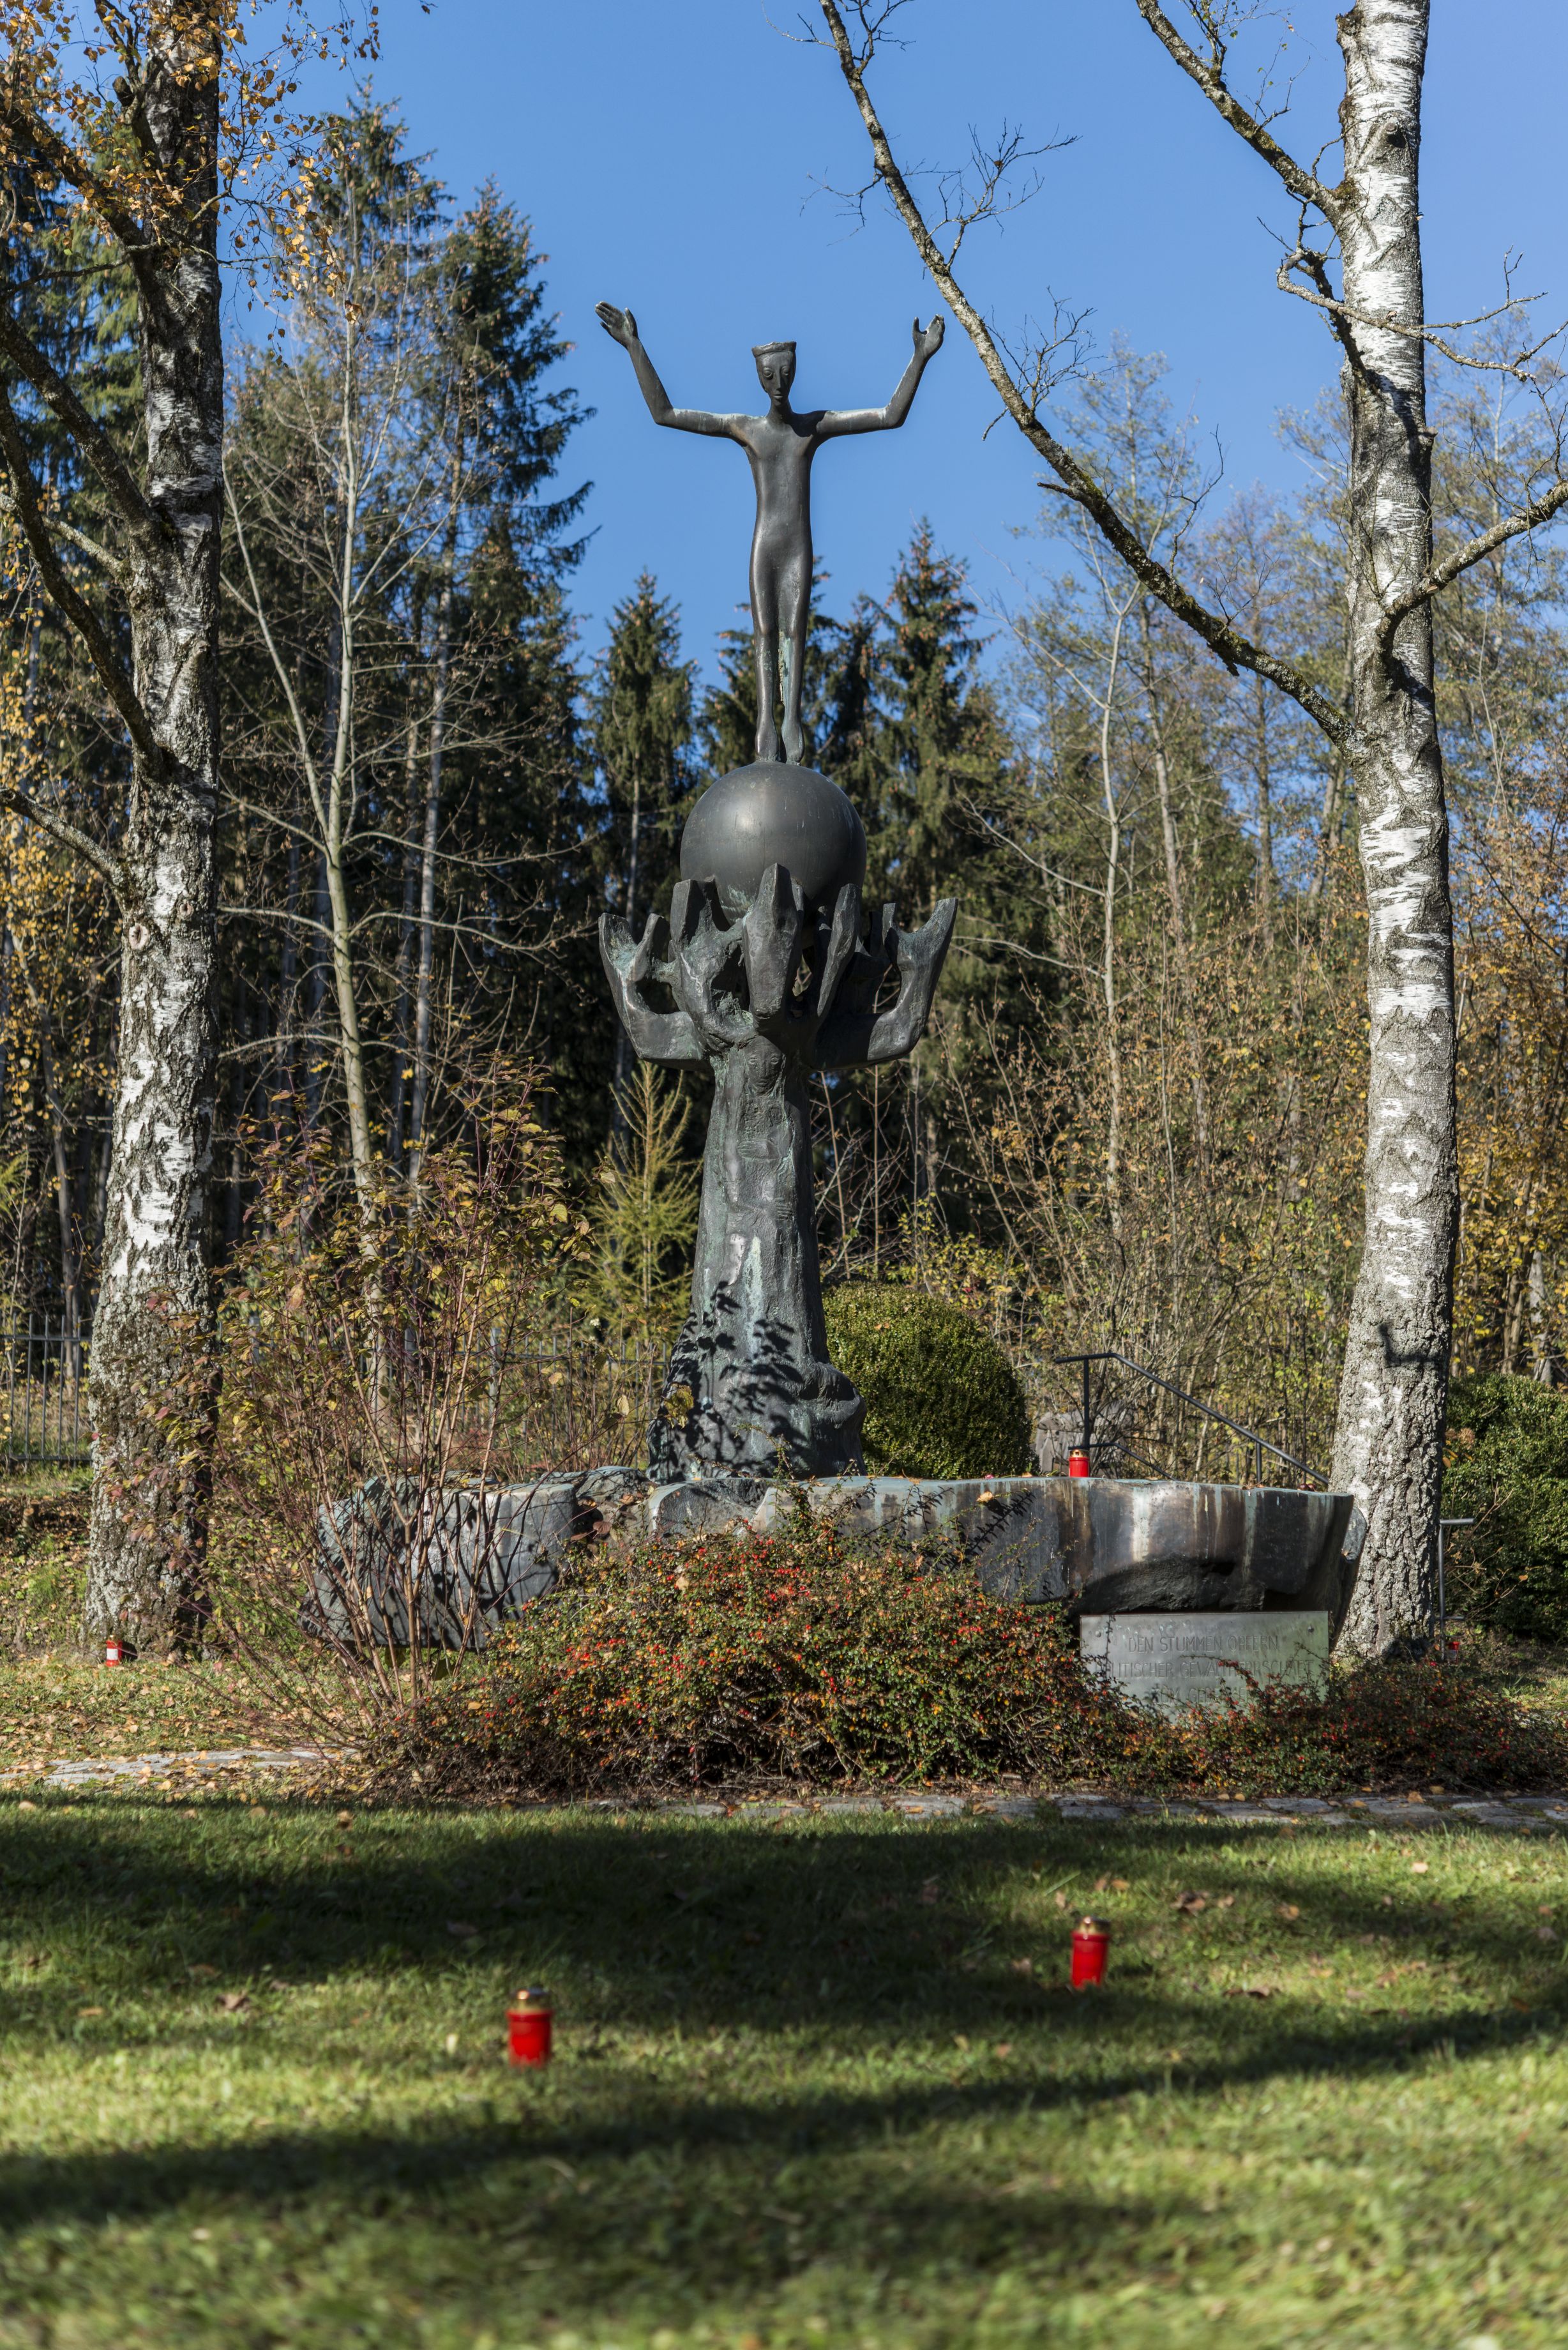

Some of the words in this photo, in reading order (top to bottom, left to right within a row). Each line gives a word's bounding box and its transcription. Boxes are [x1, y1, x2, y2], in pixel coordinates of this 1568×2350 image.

[1129, 1637, 1154, 1653] DEN
[1159, 1636, 1222, 1653] STUMMEN
[1228, 1635, 1278, 1652] OPFERN
[1151, 1687, 1181, 1703] UM
